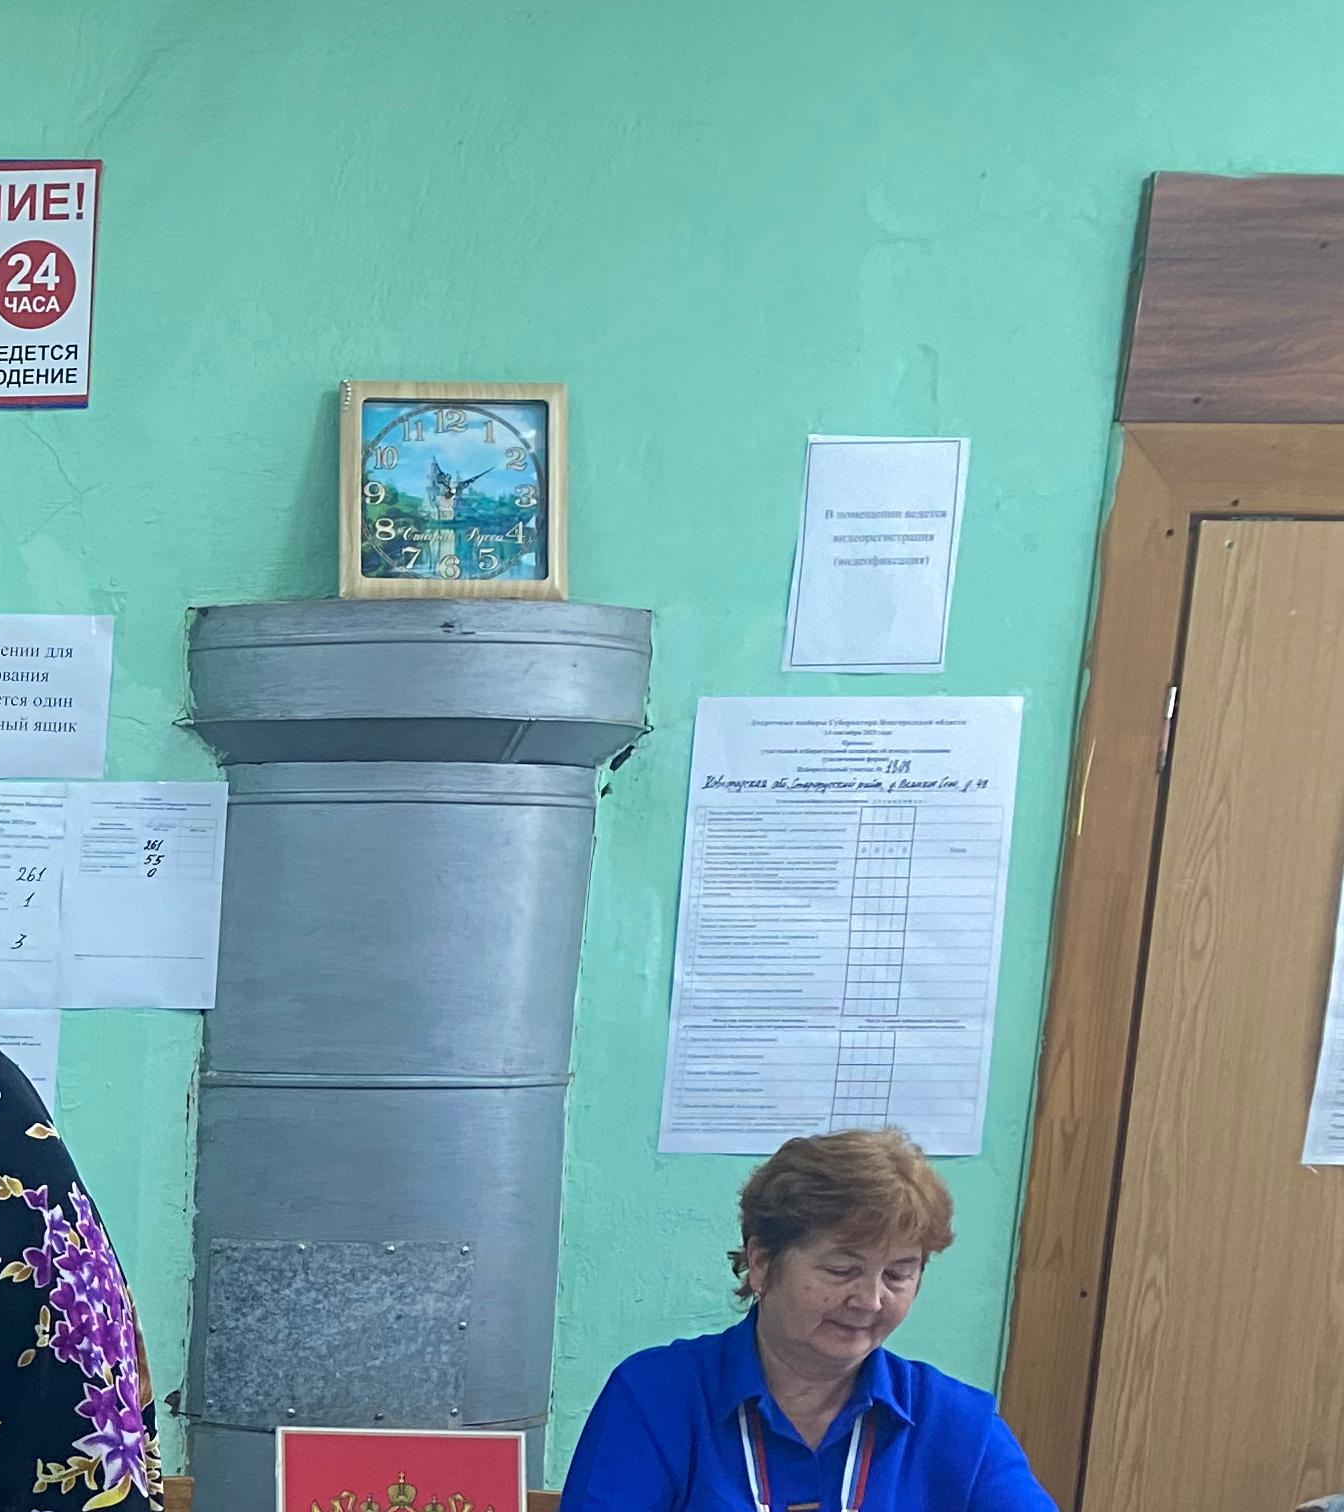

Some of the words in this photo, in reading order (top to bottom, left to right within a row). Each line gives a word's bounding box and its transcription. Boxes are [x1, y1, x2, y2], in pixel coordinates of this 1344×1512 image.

[6, 252, 60, 292] 24
[5, 296, 60, 314] ЧАСА
[401, 415, 425, 441] 11
[434, 409, 468, 433] 12
[483, 420, 495, 443] 1
[374, 446, 399, 470] 10
[505, 447, 528, 471] 2
[363, 481, 385, 505] 9
[515, 484, 537, 508] 3
[375, 518, 396, 541] 8
[505, 521, 525, 544] 4
[401, 547, 421, 569] 7
[437, 554, 461, 579] 6
[478, 548, 499, 571] 5
[44, 647, 73, 659] для
[32, 695, 73, 708] один
[34, 721, 78, 734] ящик
[143, 840, 164, 851] 261
[143, 854, 165, 866] 55
[16, 867, 47, 882] 261
[146, 867, 158, 878] 0
[23, 892, 35, 907] 1
[11, 933, 27, 950] 3
